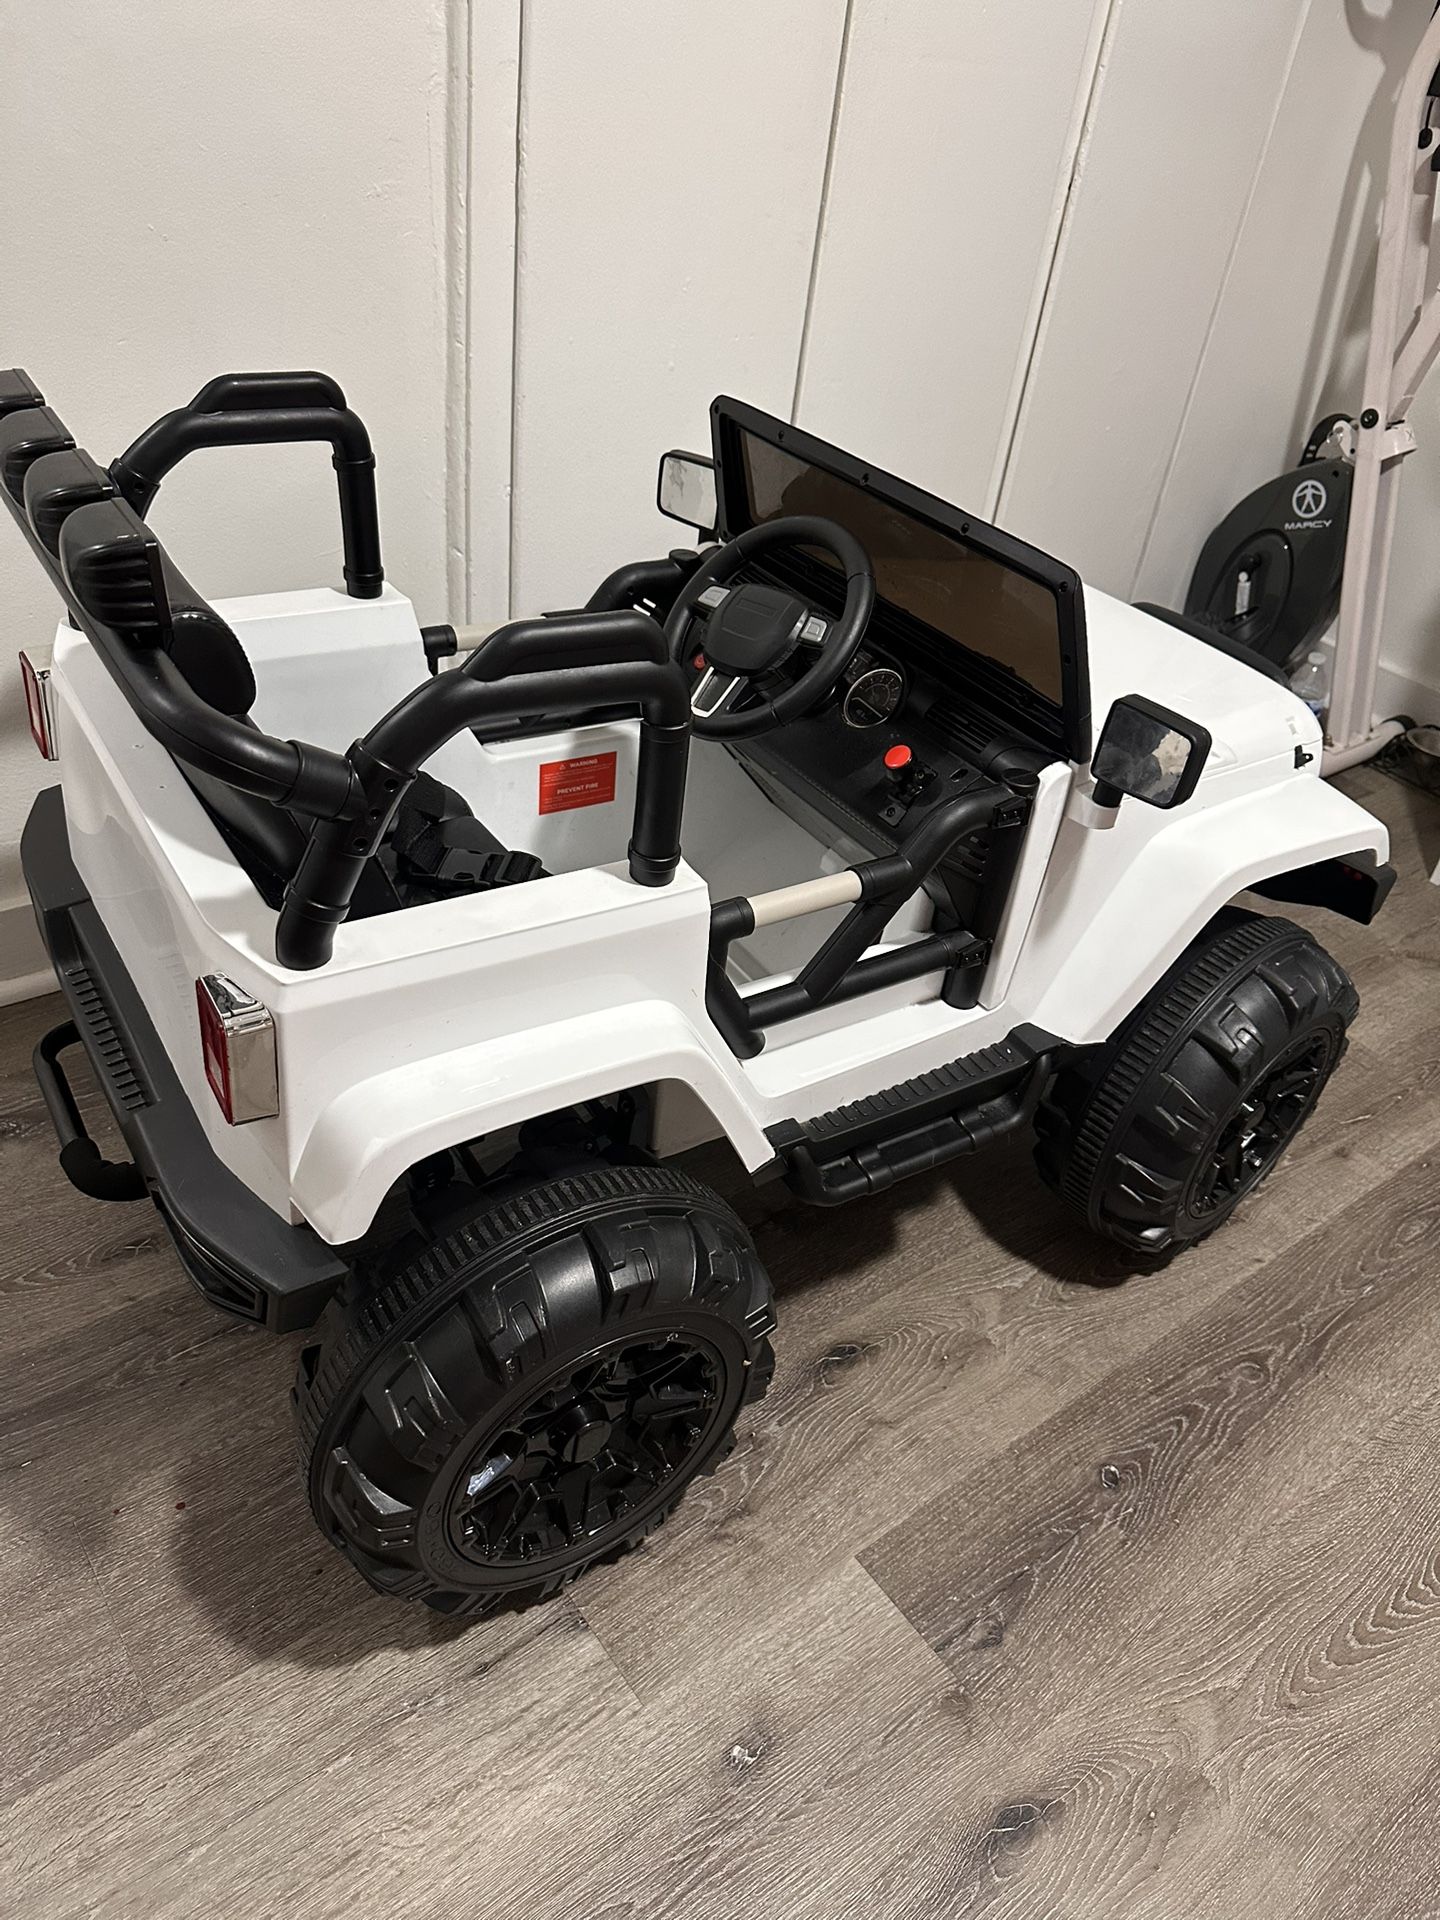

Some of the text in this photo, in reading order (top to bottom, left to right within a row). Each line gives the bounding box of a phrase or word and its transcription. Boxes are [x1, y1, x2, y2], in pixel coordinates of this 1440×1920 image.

[1284, 519, 1332, 530] MARCY
[569, 758, 598, 768] WARNING
[556, 782, 599, 795] PREVENT FIRE
